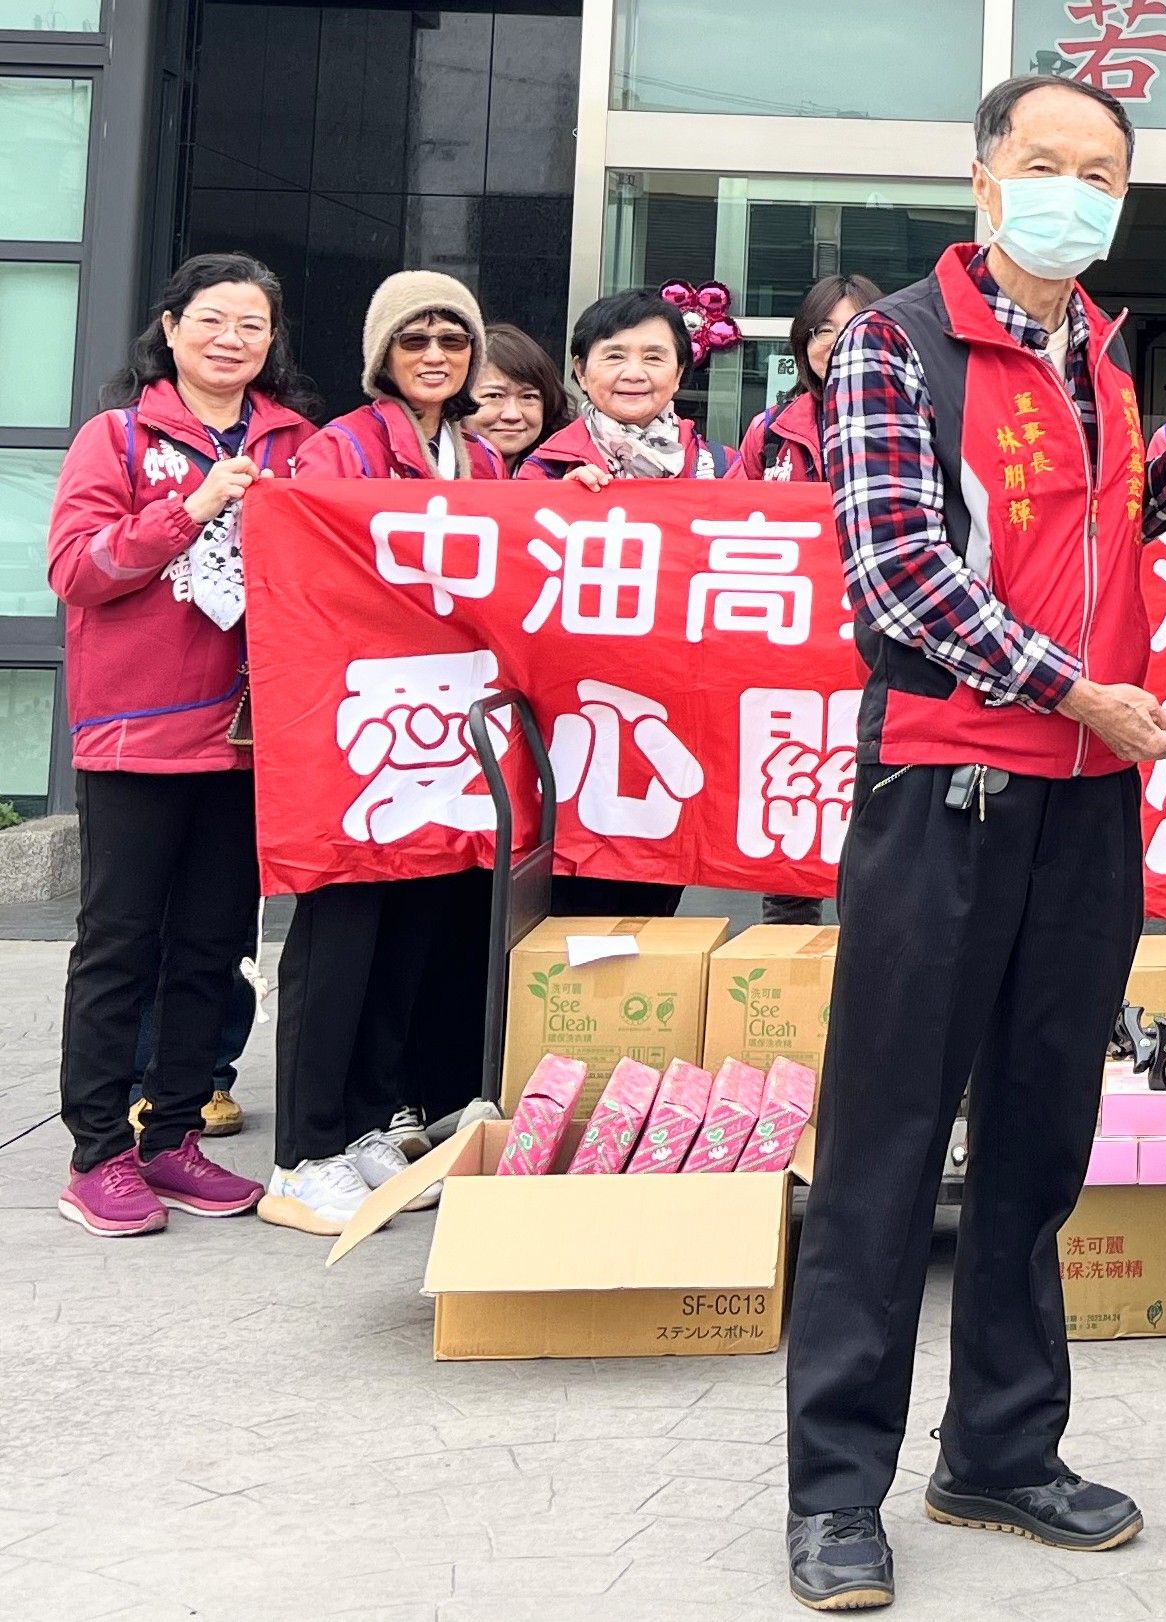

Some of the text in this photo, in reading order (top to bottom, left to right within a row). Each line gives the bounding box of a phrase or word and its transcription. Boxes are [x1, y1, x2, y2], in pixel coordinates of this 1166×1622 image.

[1013, 391, 1057, 475] 董事長
[996, 424, 1035, 532] 林朋輝
[365, 494, 856, 646] 中油高
[549, 996, 581, 1014] See
[750, 1000, 780, 1018] See
[549, 1014, 597, 1033] Clean
[749, 1019, 797, 1038] Clean
[1066, 1236, 1125, 1255] 洗可麗
[682, 1294, 766, 1316] SF-CC13
[656, 1324, 764, 1340] ステンレスボトル
